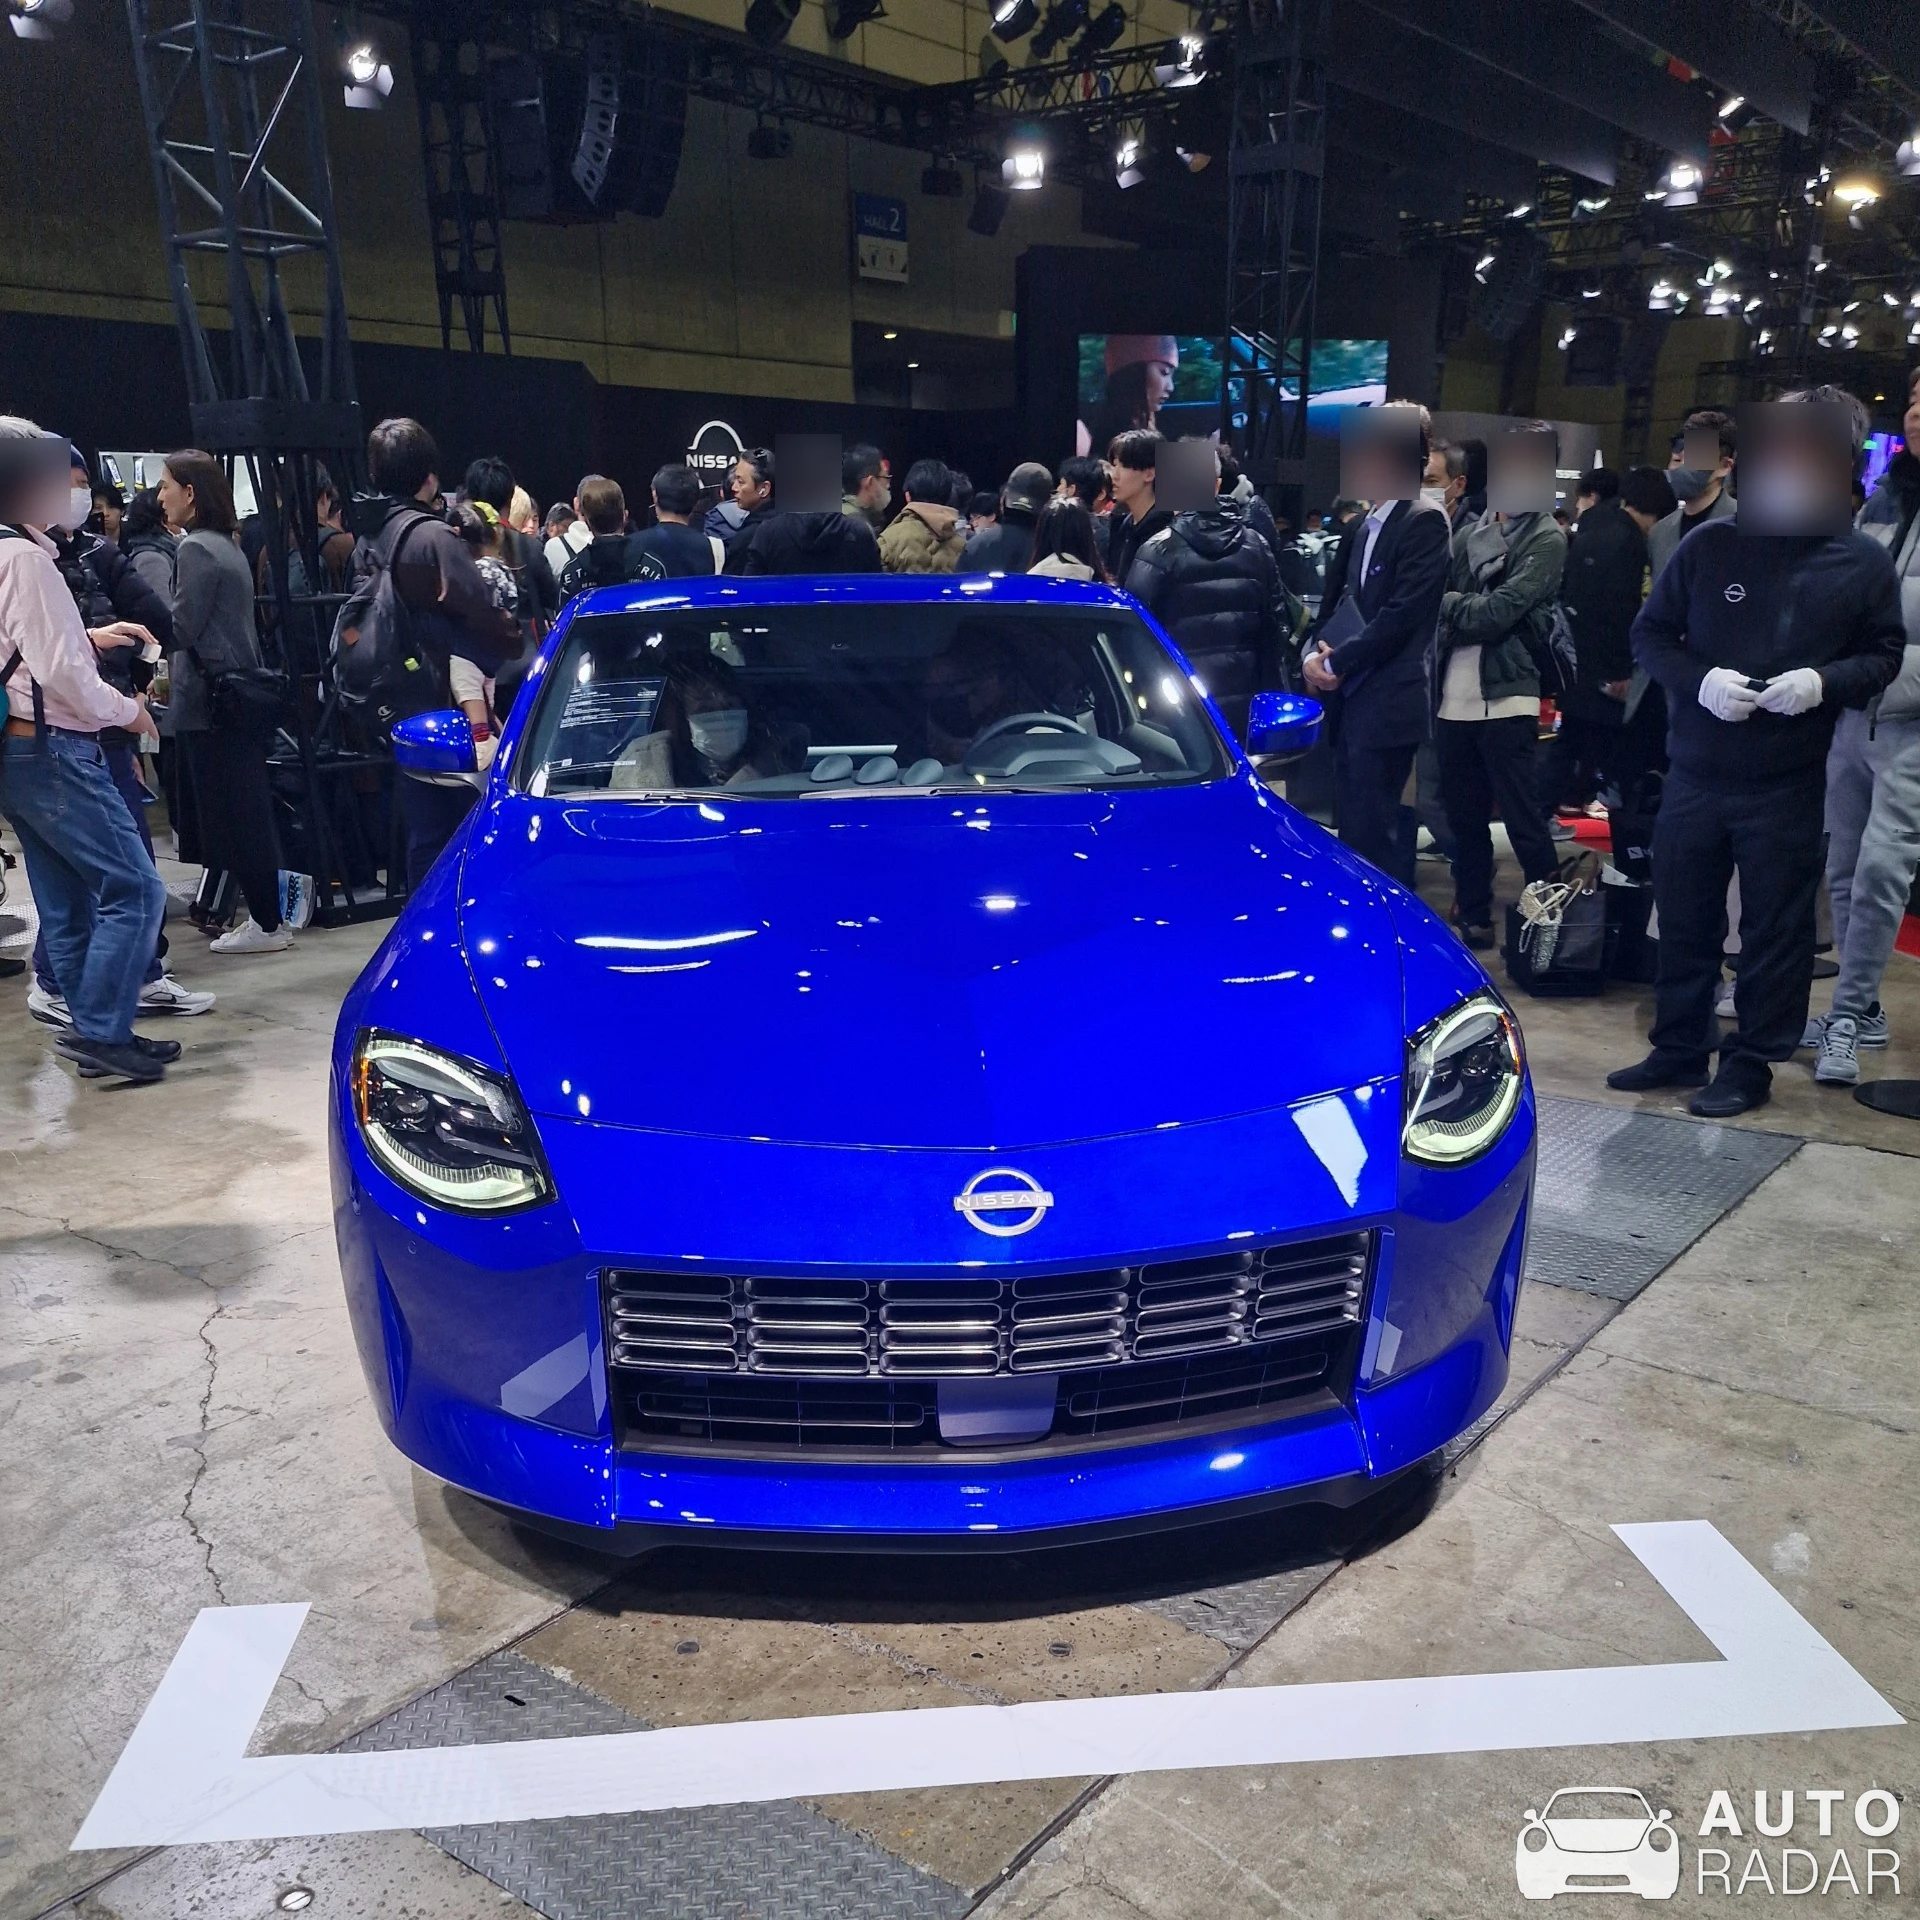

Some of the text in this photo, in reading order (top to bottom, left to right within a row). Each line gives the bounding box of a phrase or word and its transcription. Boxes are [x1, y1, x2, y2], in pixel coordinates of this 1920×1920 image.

[889, 207, 901, 232] 2
[685, 454, 738, 469] NISSA
[956, 1194, 1049, 1208] NISSAN
